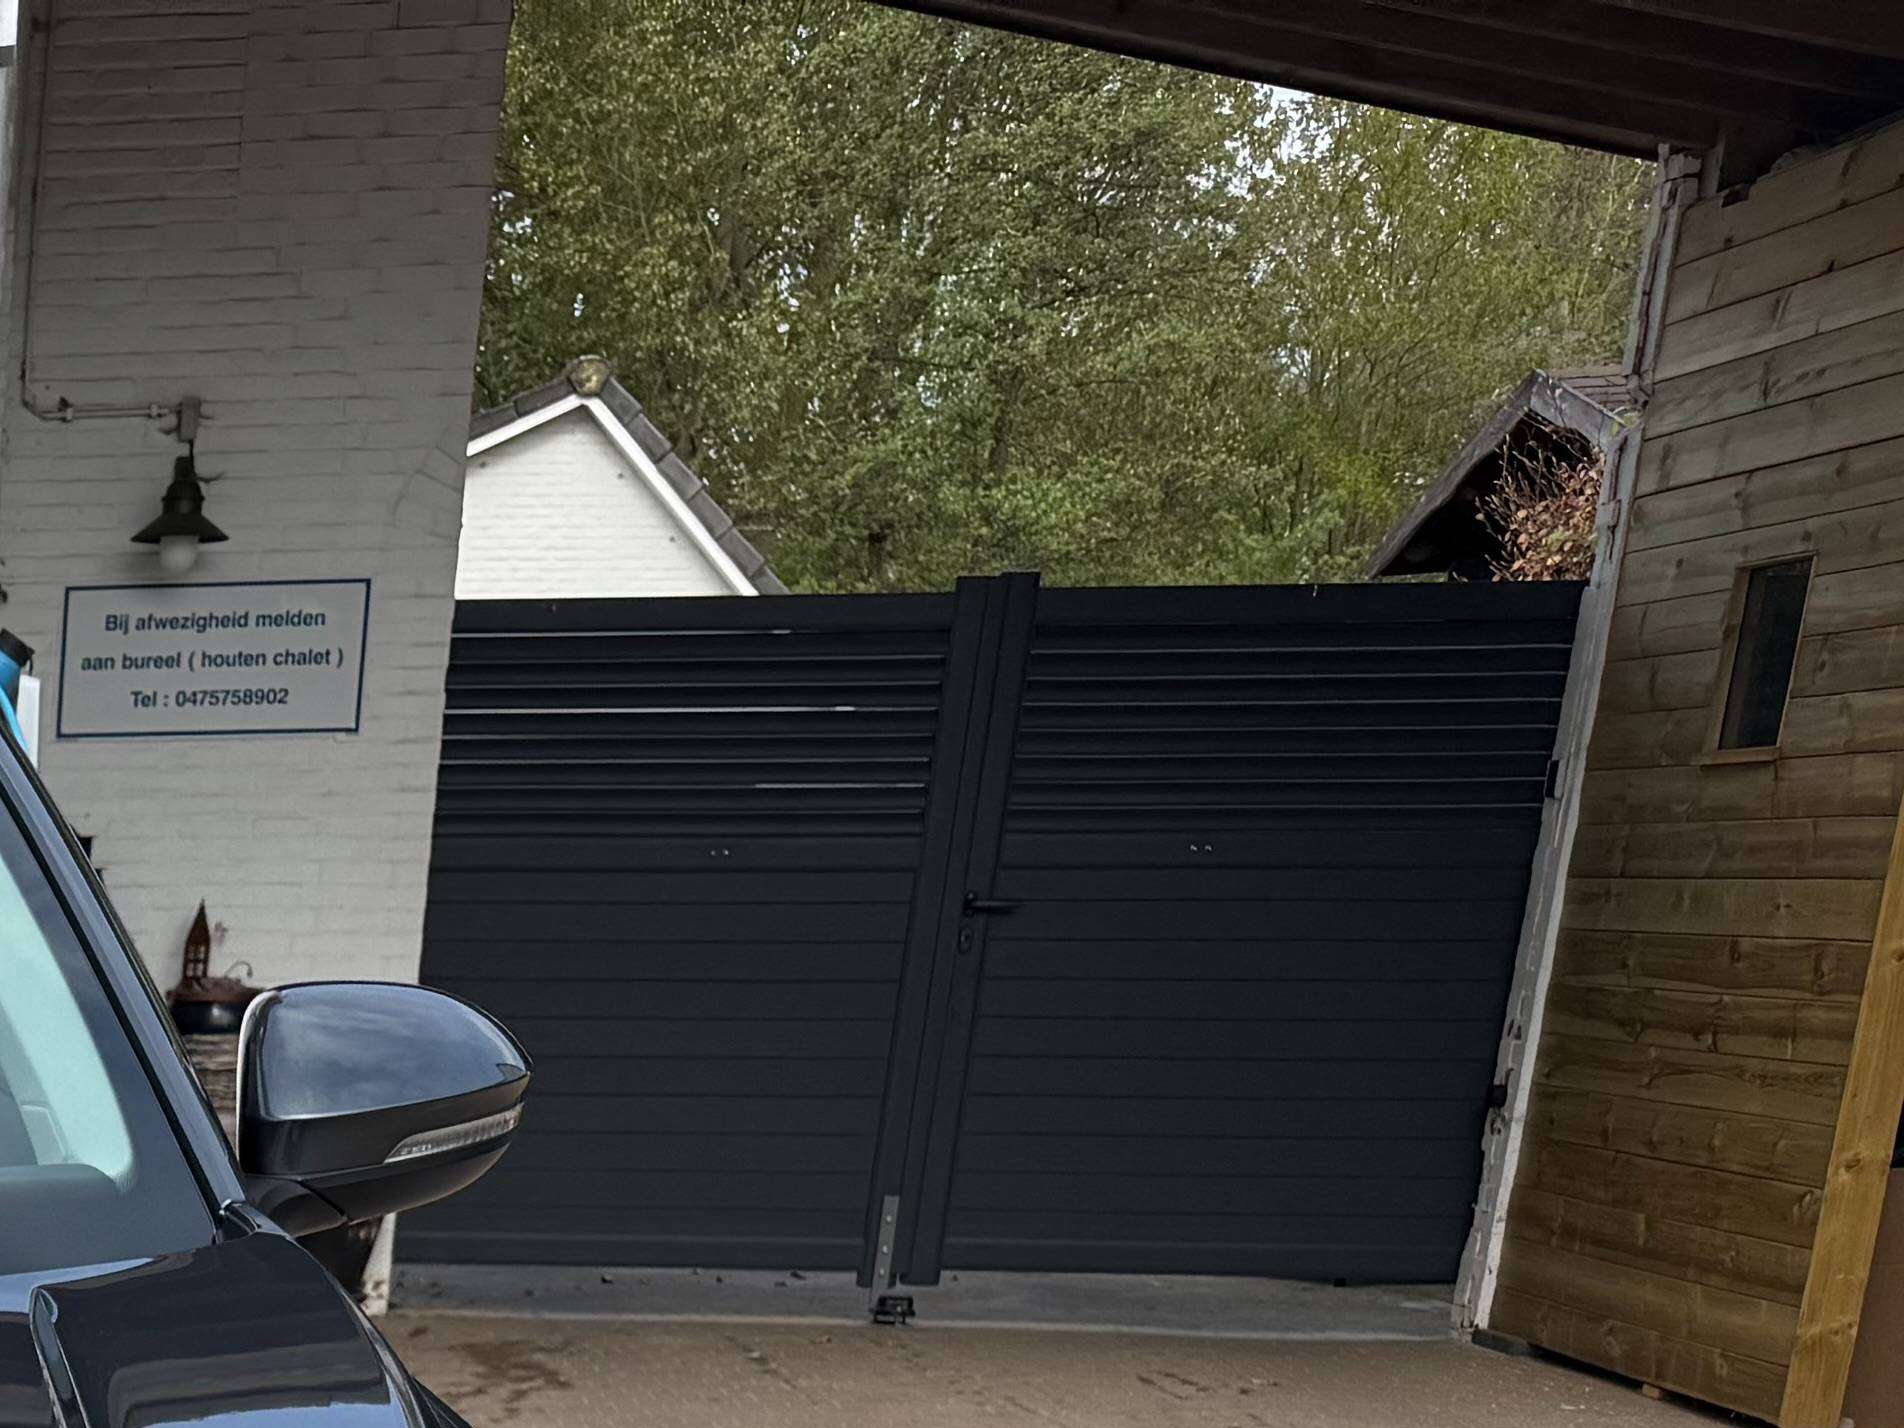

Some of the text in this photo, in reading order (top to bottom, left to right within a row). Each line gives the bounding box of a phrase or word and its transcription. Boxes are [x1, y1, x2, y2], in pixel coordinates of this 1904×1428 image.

[105, 609, 326, 635] Bij afwezigheid melden
[81, 654, 116, 671] aan
[122, 652, 182, 670] bureel
[200, 650, 267, 668] houten
[273, 648, 331, 666] chalet
[130, 691, 157, 708] Tel
[175, 687, 289, 707] 0475758902
